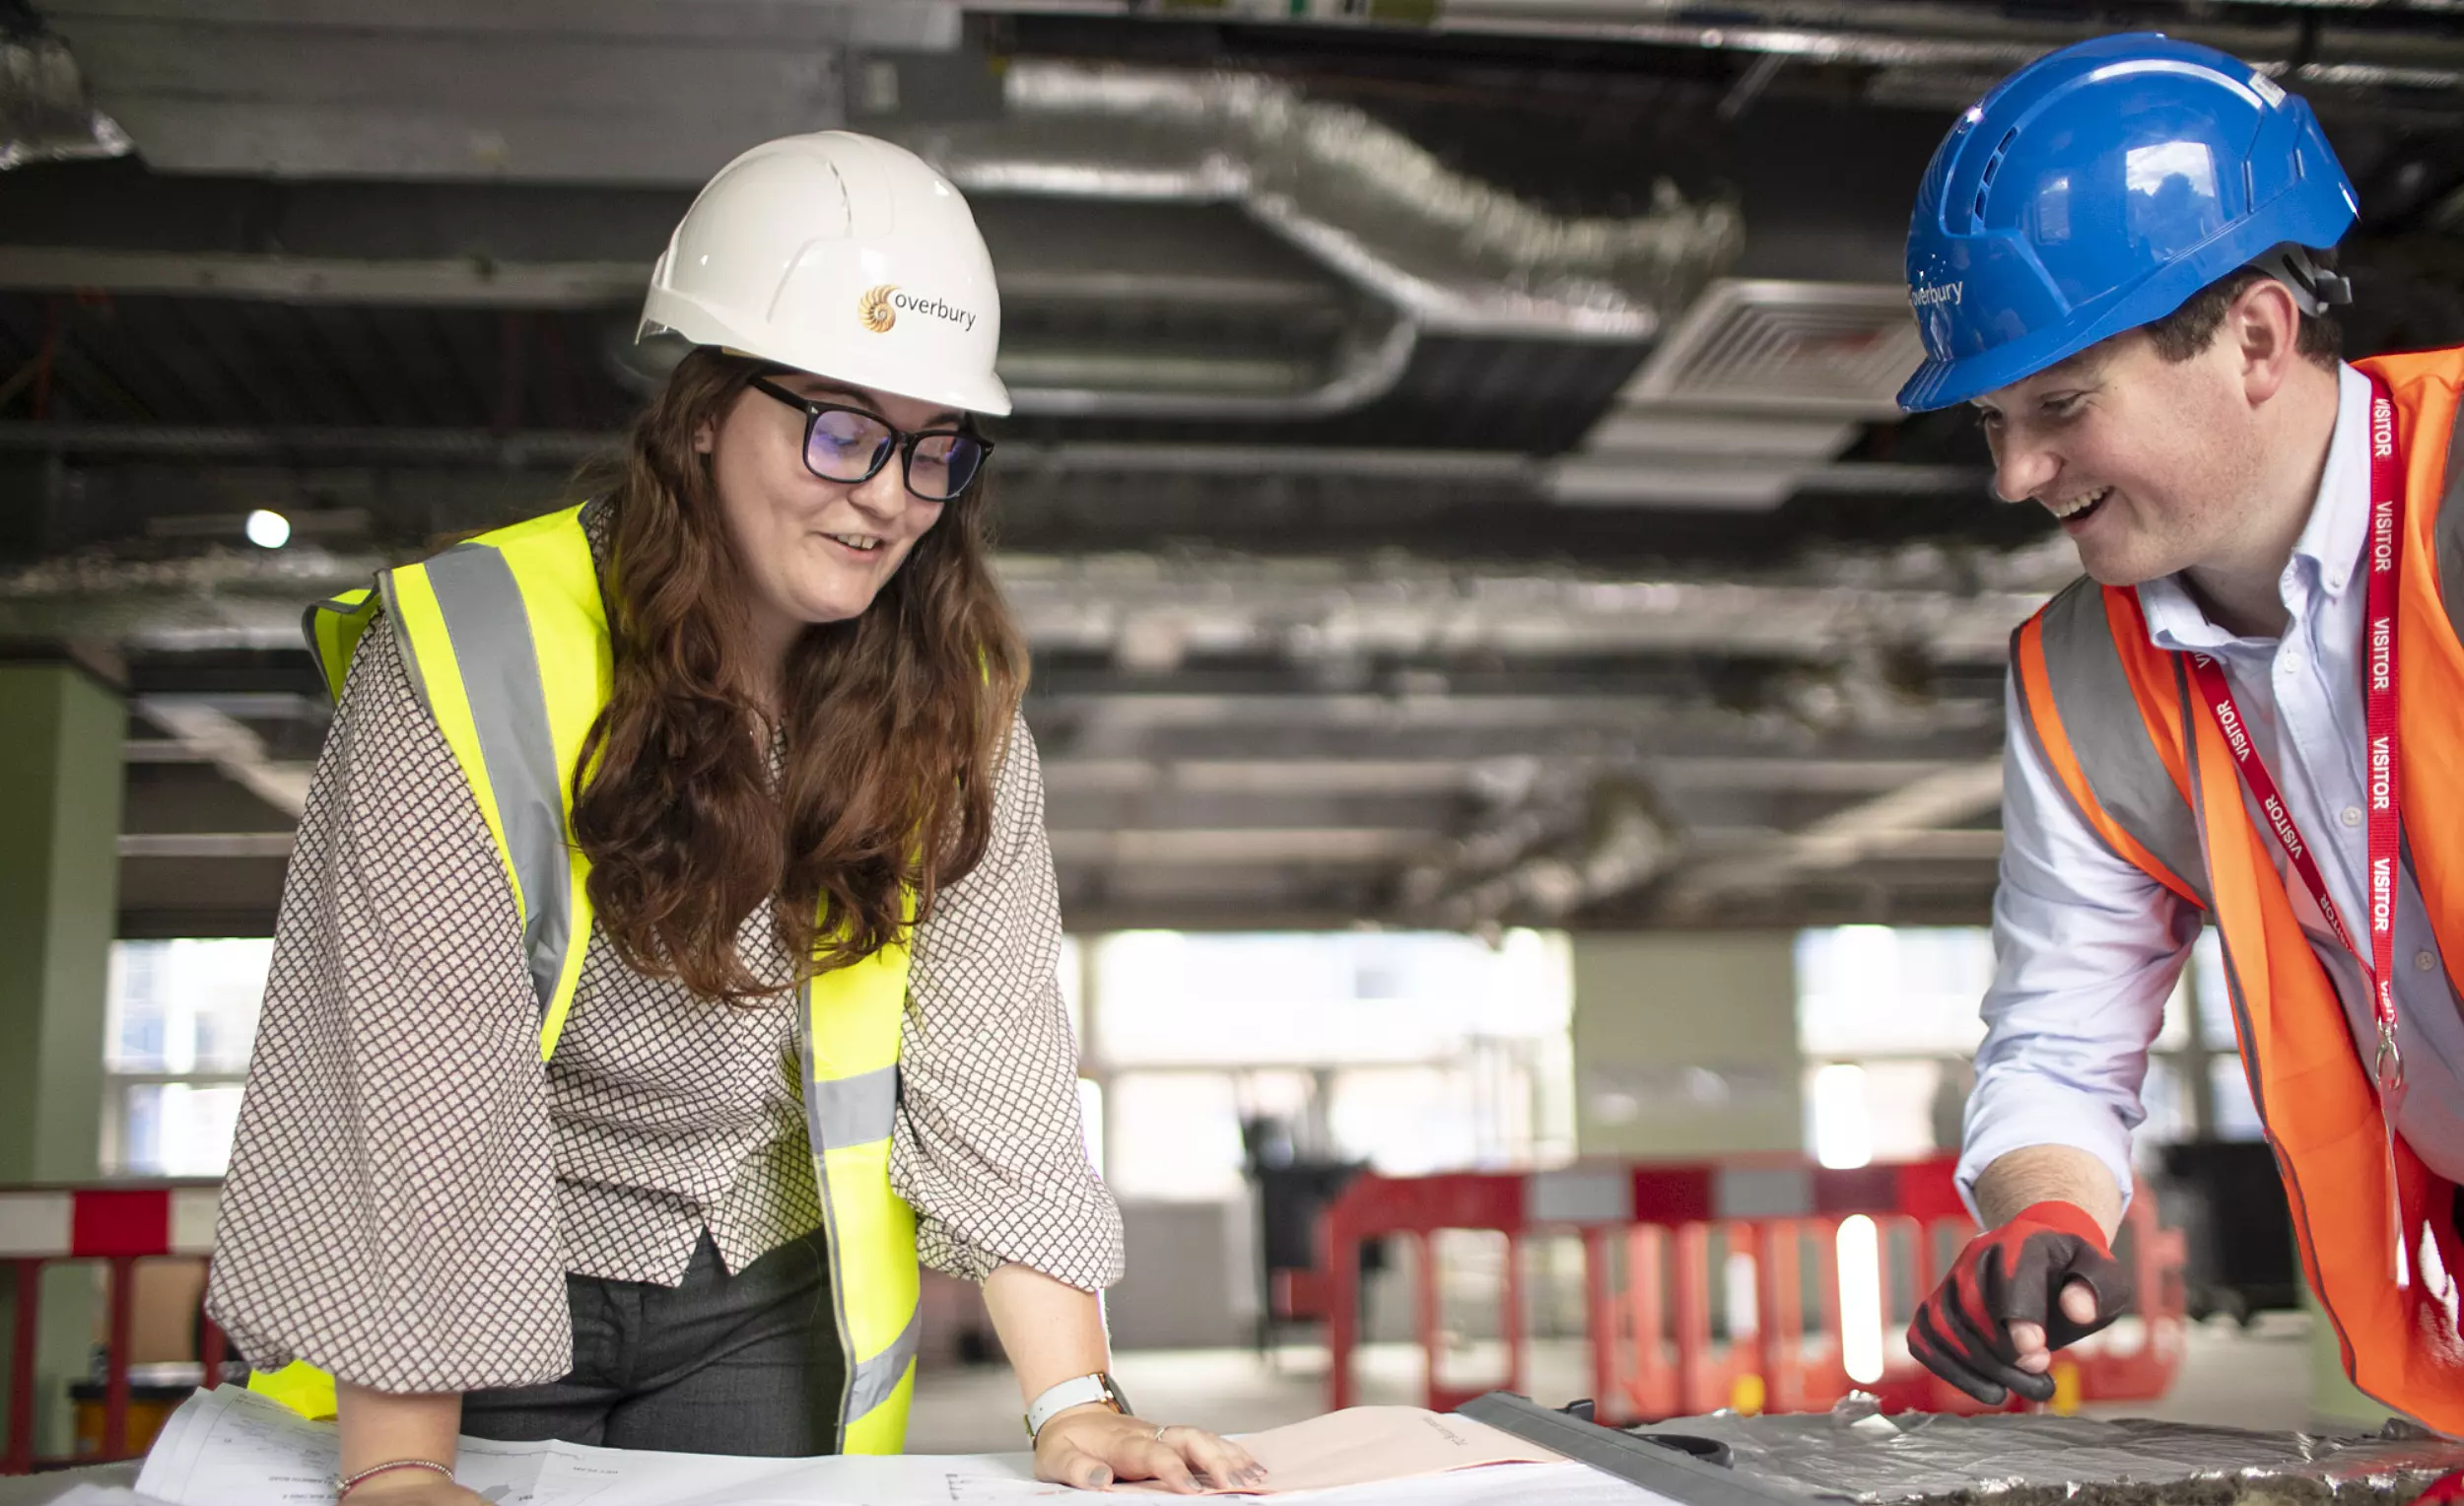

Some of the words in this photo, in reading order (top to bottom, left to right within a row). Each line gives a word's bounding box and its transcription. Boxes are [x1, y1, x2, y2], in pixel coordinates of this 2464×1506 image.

[895, 294, 976, 331] overbury
[1912, 281, 1963, 306] overbury
[2373, 397, 2392, 457] VISITOR
[2374, 500, 2394, 573] VISITOR
[2372, 617, 2390, 690] VISITOR
[2216, 699, 2250, 762] VISITOR
[2372, 736, 2390, 810] VISITOR
[2265, 793, 2303, 860] VISITOR
[2373, 857, 2391, 931] VISITOR
[2379, 980, 2396, 1022] VISIT
